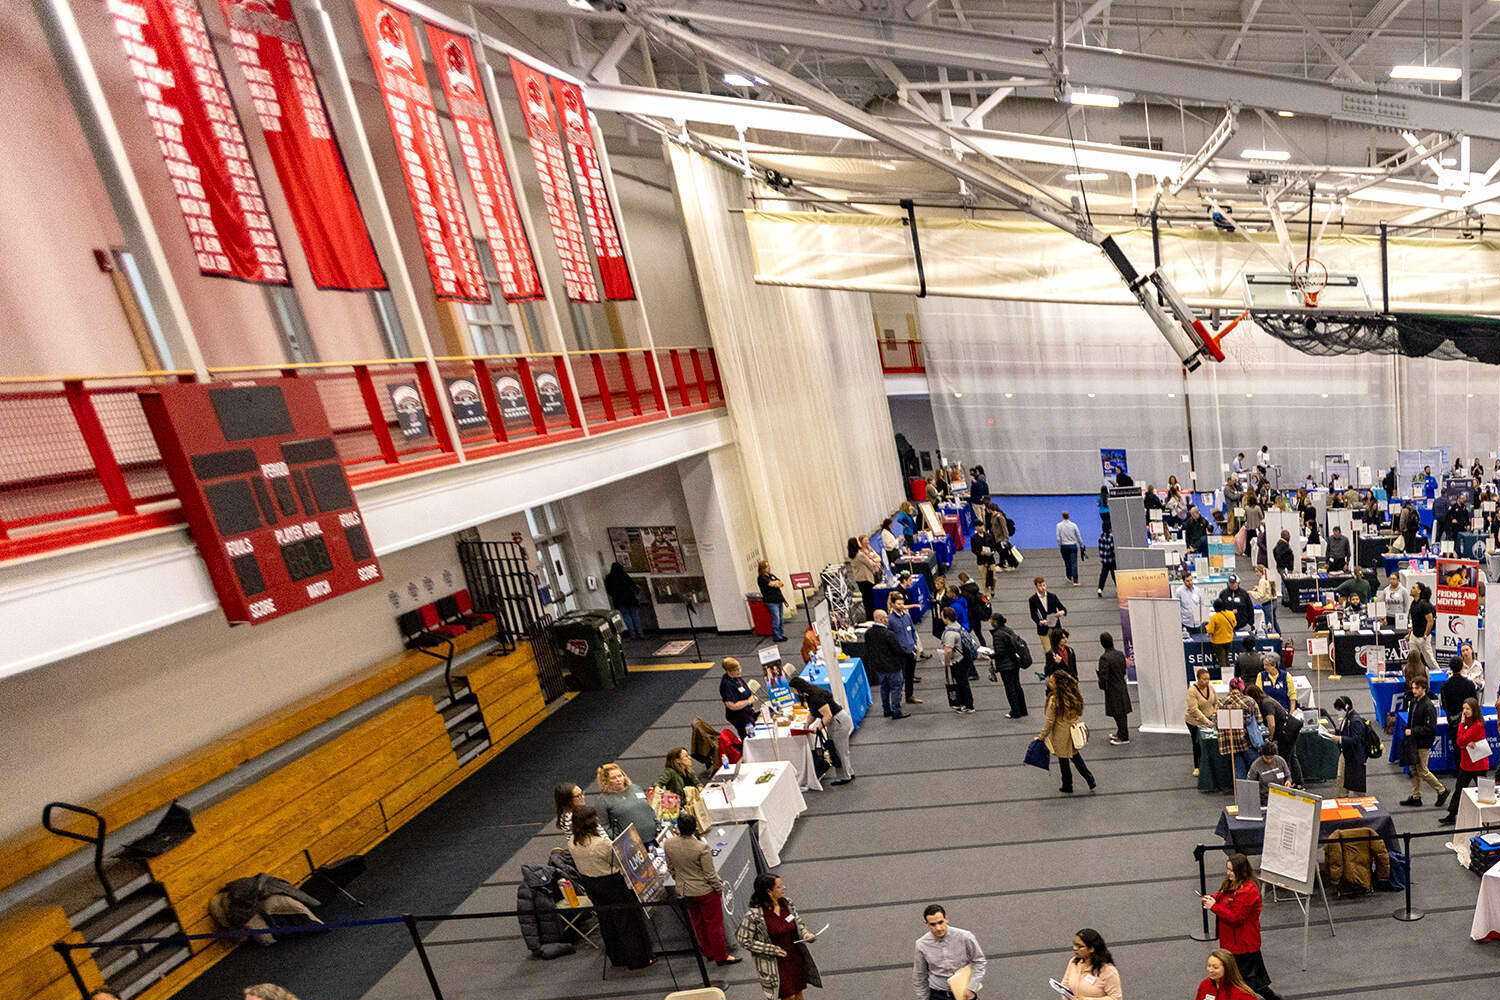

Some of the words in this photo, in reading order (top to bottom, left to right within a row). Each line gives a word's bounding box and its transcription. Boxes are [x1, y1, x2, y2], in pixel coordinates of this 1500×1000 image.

[261, 461, 289, 479] PERIOD
[338, 510, 361, 528] FOULS
[274, 525, 305, 546] PLAYER
[303, 521, 324, 538] FOUL
[225, 537, 254, 558] FOULS
[357, 563, 380, 582] SCORE
[306, 579, 332, 600] MATCH
[1437, 589, 1462, 599] FRIENDS
[1463, 591, 1477, 600] AND
[249, 598, 277, 618] SCORE
[1437, 597, 1466, 607] MENTORS
